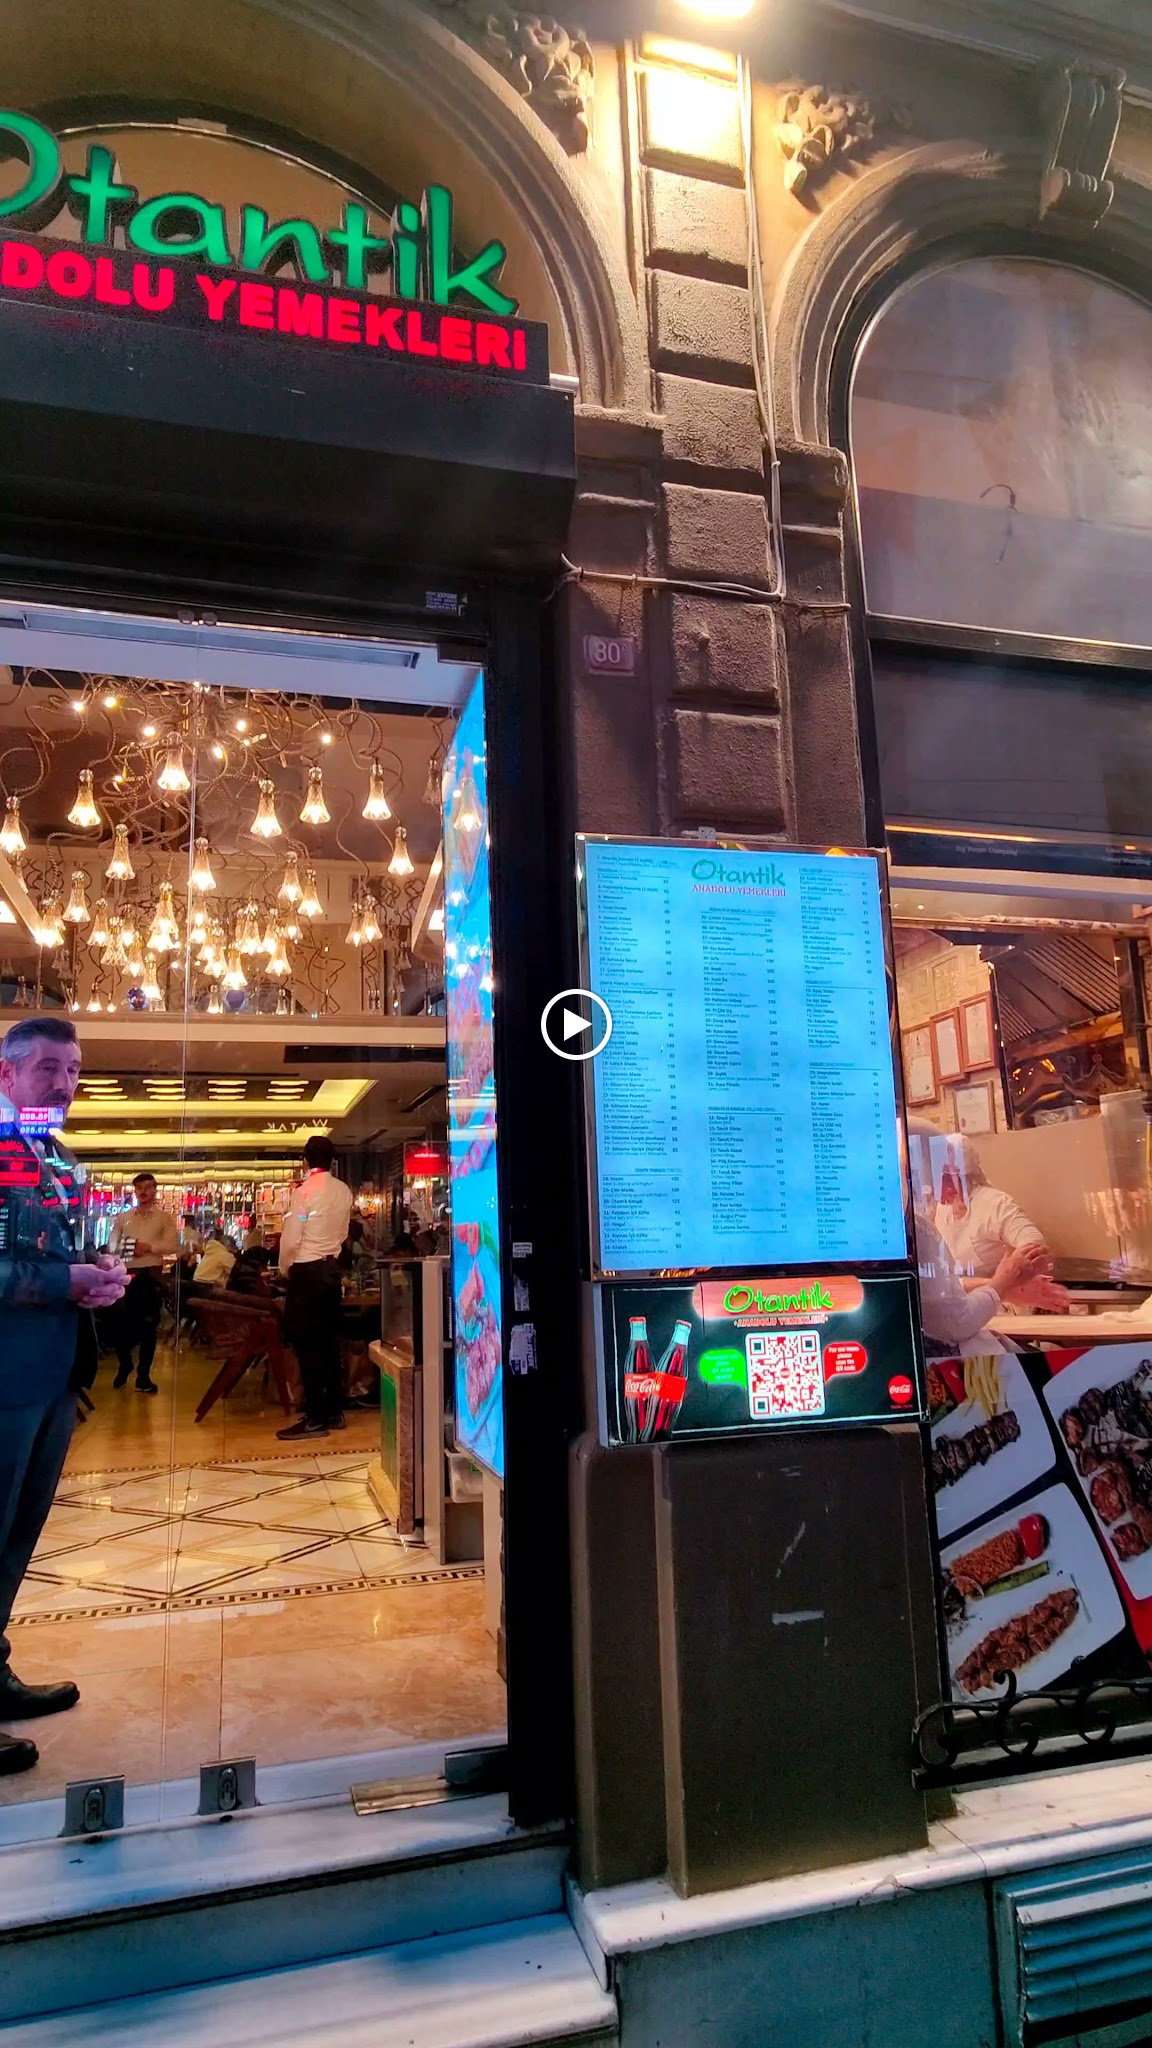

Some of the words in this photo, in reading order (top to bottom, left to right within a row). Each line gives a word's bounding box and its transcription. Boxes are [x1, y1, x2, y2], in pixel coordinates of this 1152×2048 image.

[595, 640, 621, 664] 80
[691, 858, 786, 887] Otantik
[692, 883, 735, 895] ANADOLU
[723, 1281, 833, 1313] Otantik
